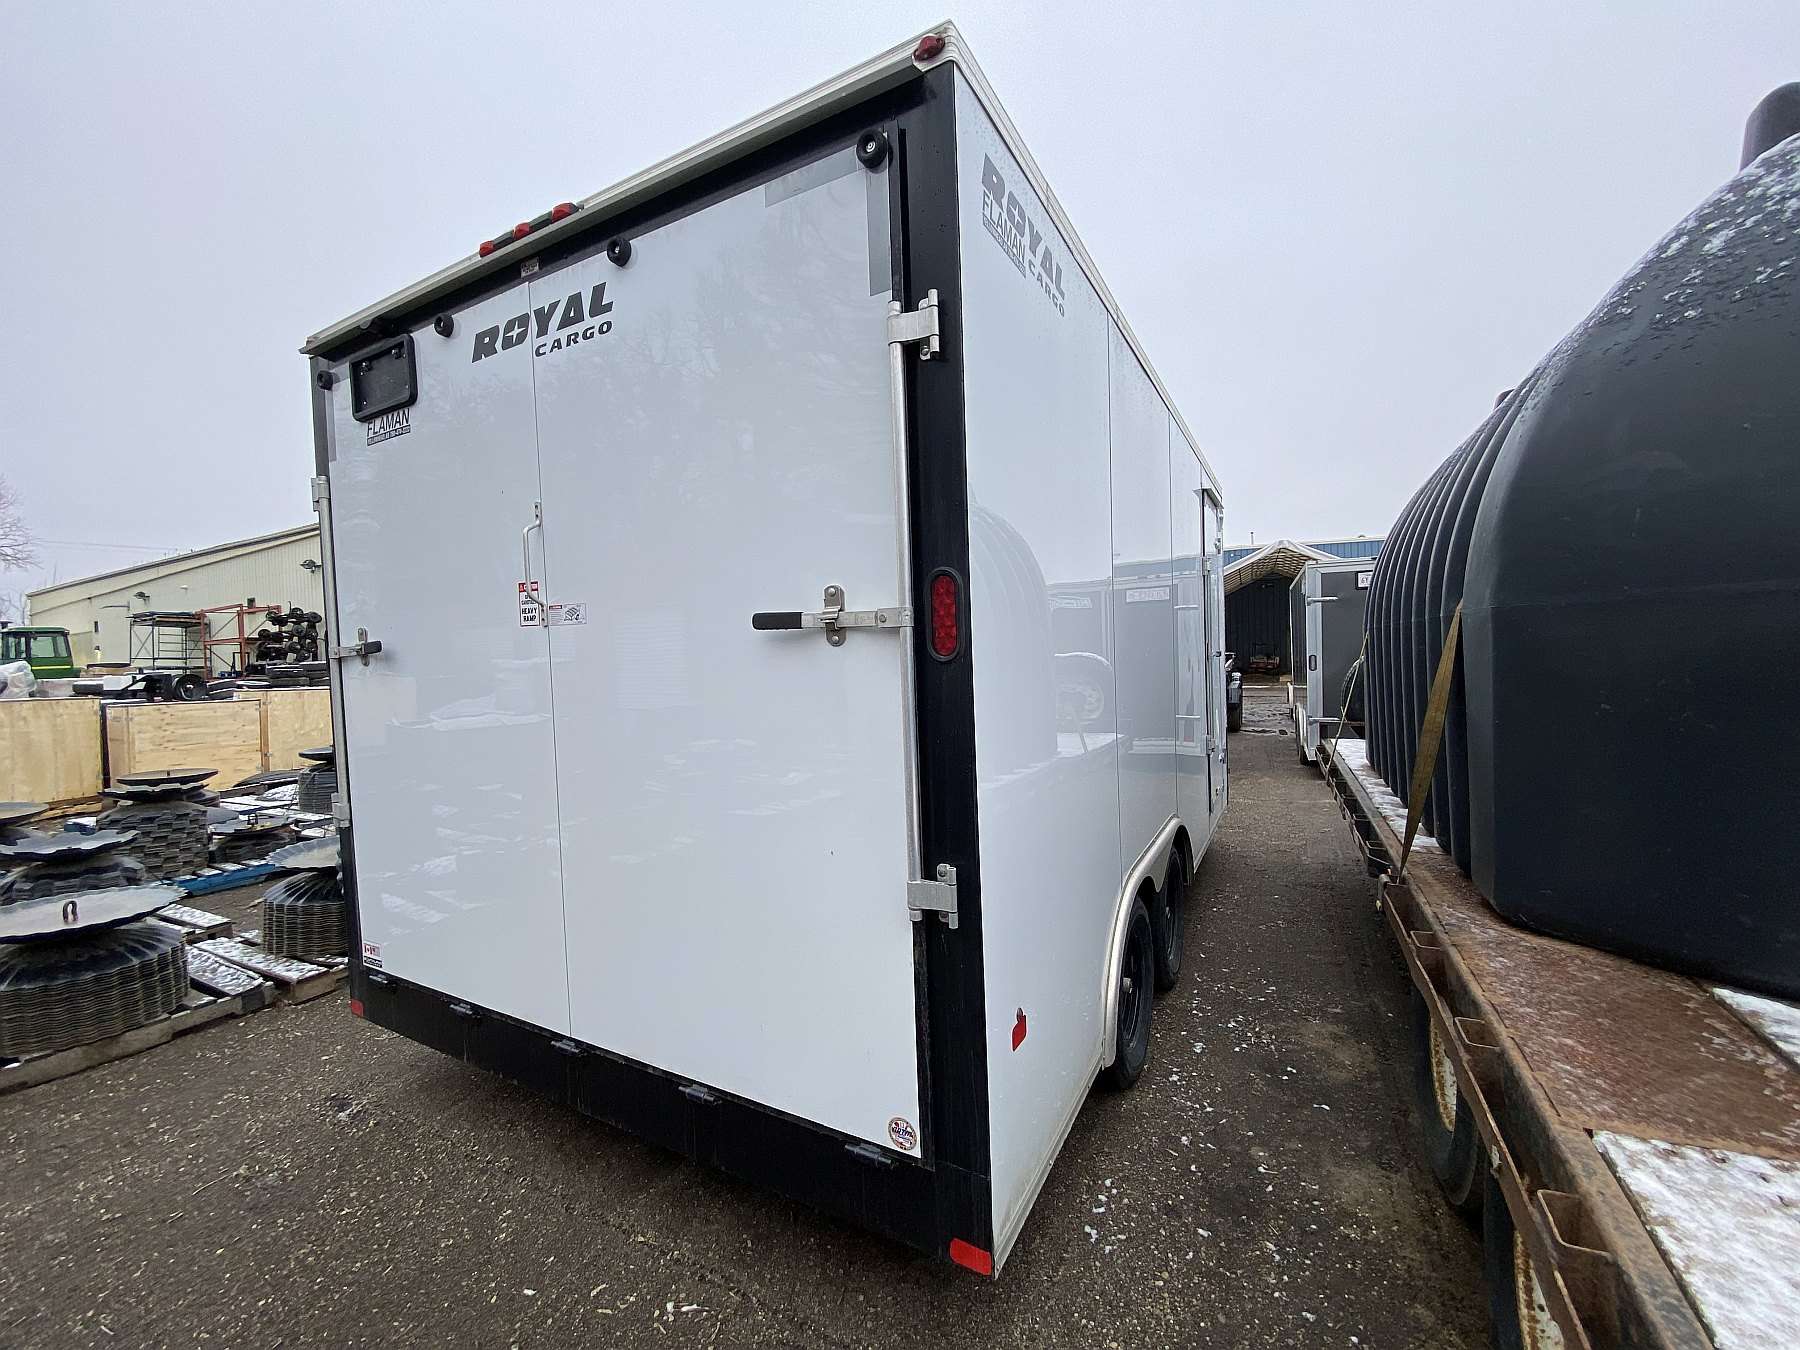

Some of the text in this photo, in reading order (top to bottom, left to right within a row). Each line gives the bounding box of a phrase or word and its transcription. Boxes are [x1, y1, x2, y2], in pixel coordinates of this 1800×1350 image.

[982, 152, 1065, 301] ROYAL
[982, 189, 1026, 264] FLAMAN
[1028, 258, 1065, 317] CARGO
[472, 281, 614, 363] ROYAL
[535, 320, 613, 357] CARGO
[367, 408, 410, 437] FLAMAN
[521, 607, 538, 615] HEAVY
[523, 614, 537, 622] RAMP
